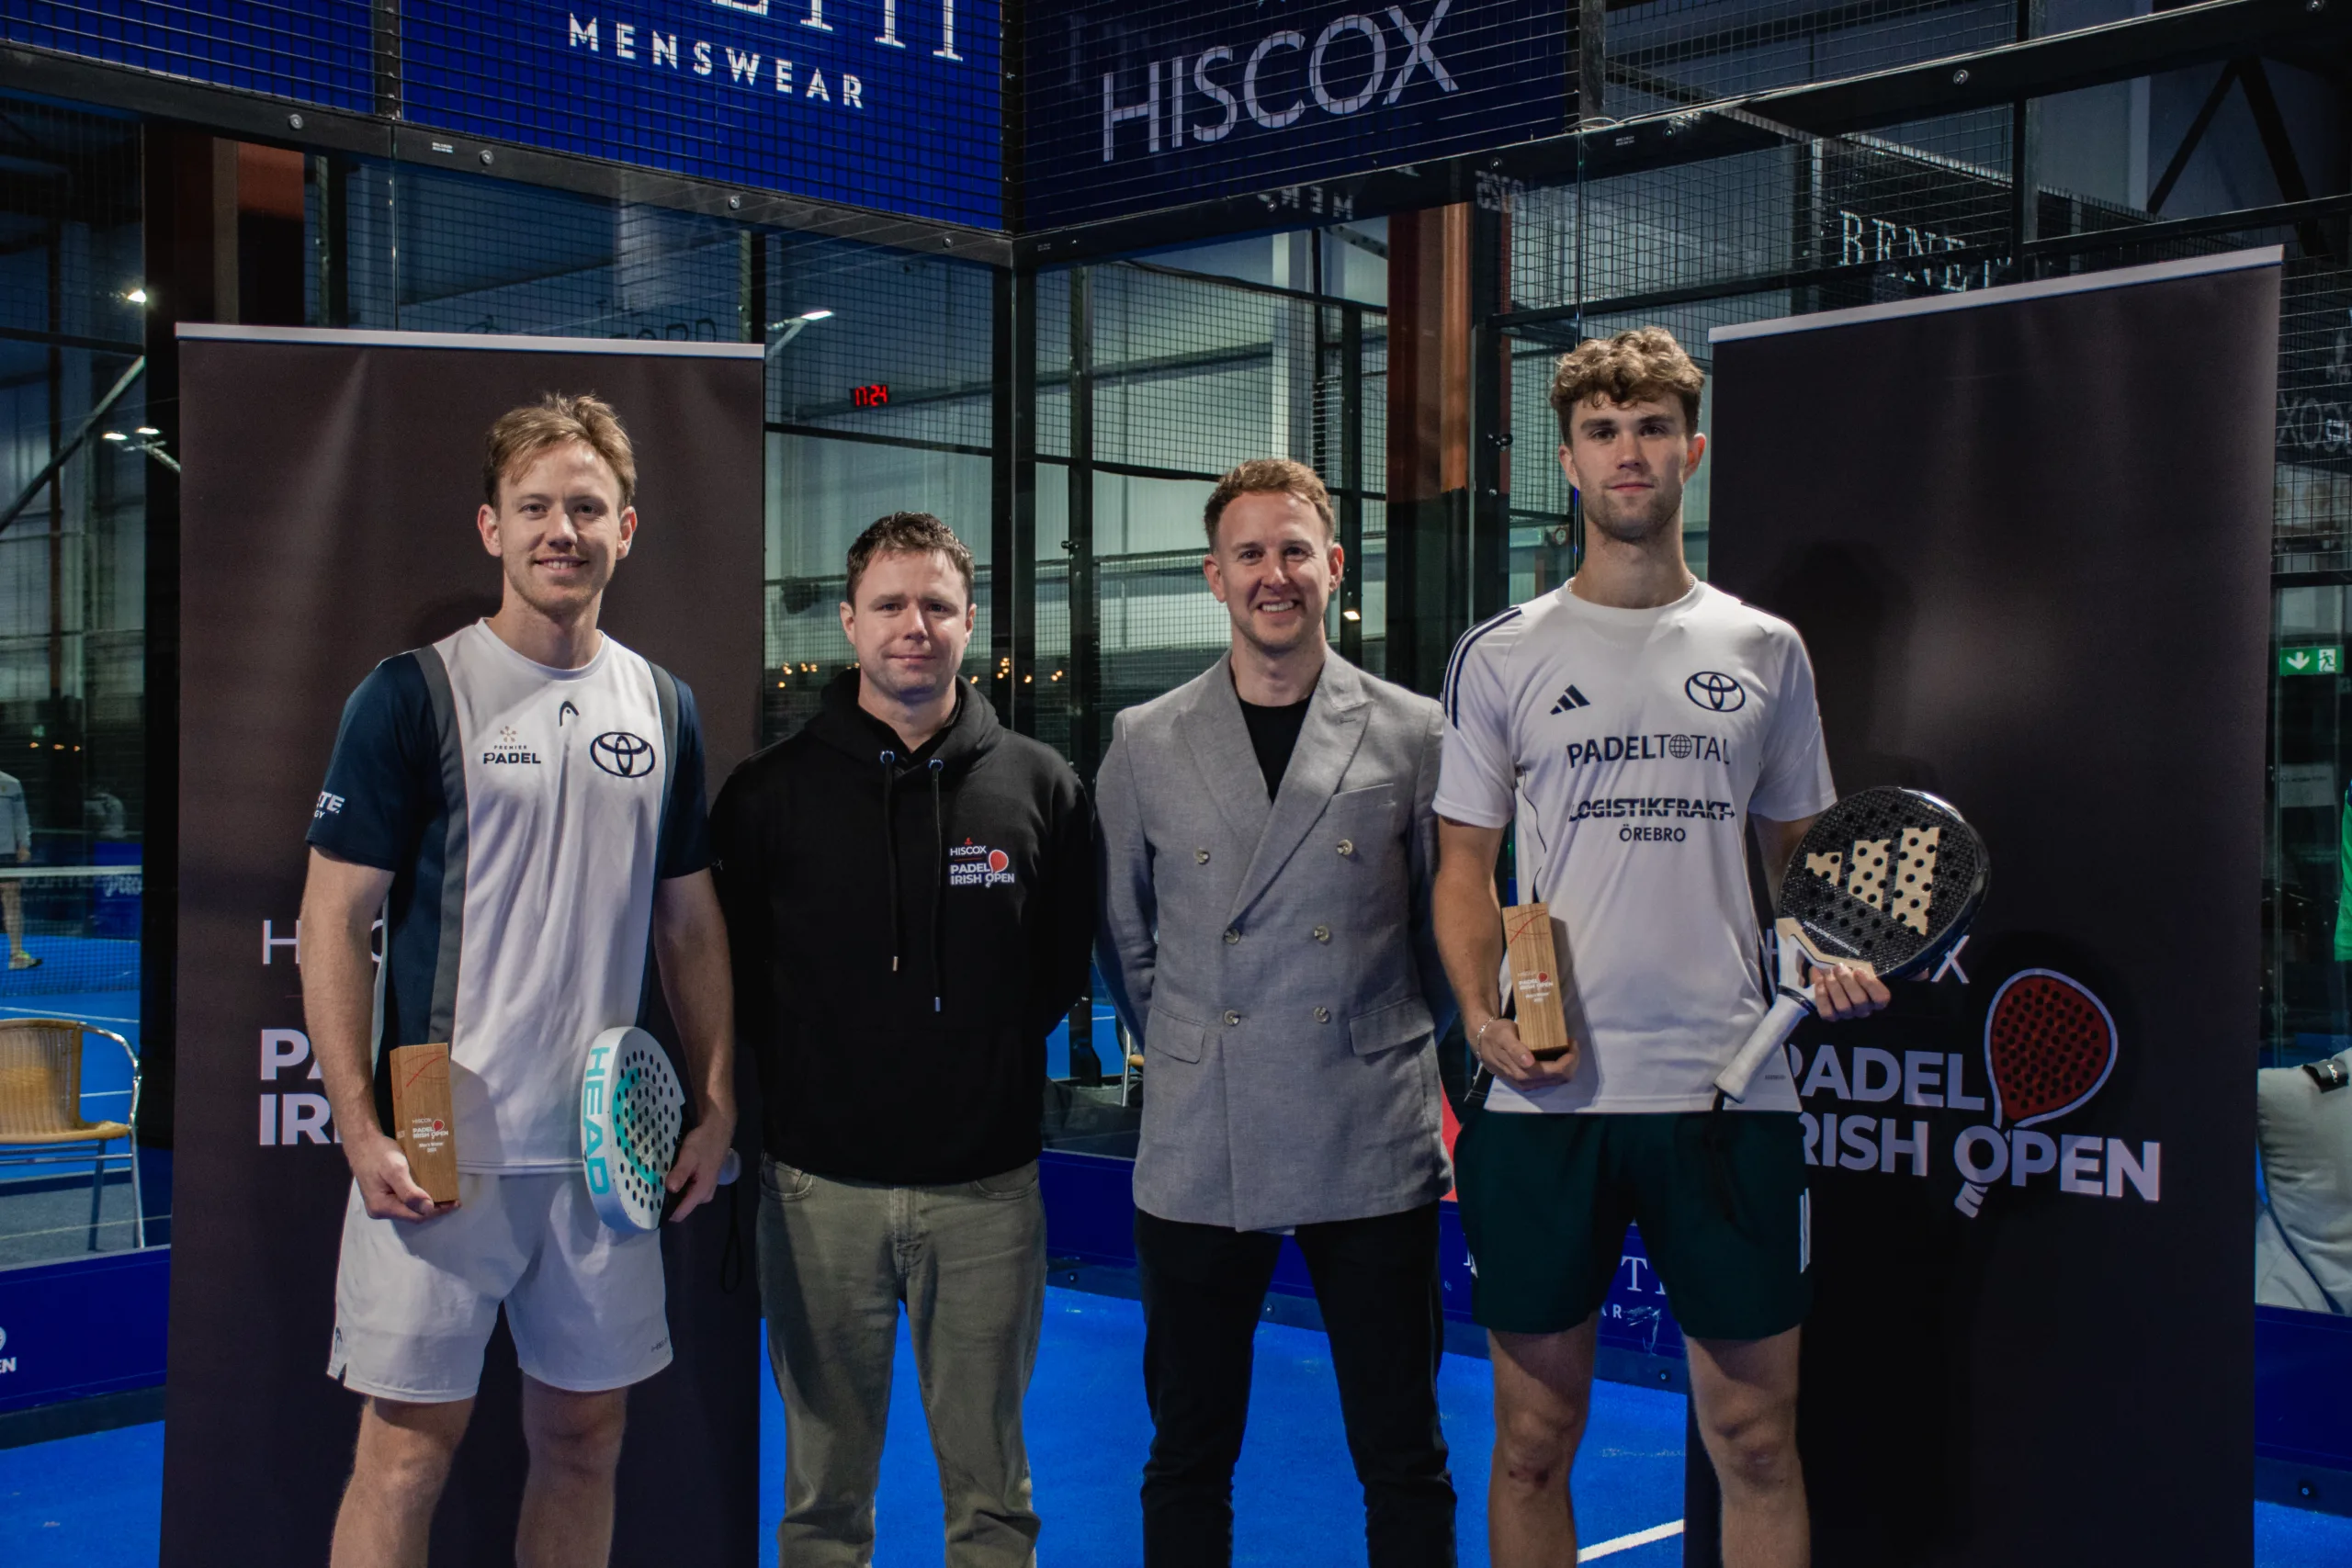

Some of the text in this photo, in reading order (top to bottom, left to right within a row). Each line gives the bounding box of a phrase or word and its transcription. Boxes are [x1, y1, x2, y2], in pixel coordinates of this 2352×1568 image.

[569, 12, 864, 108] MENSWEAR
[1103, 0, 1459, 162] HISCOX
[482, 752, 541, 764] PADEL
[1619, 824, 1686, 842] ÖREBRO
[950, 845, 987, 856] HISCOX
[950, 863, 990, 874] PADEL
[951, 873, 1014, 886] IRISH OPEN
[582, 1046, 619, 1195] HEAD
[1798, 1111, 2160, 1202] RISH OPEN
